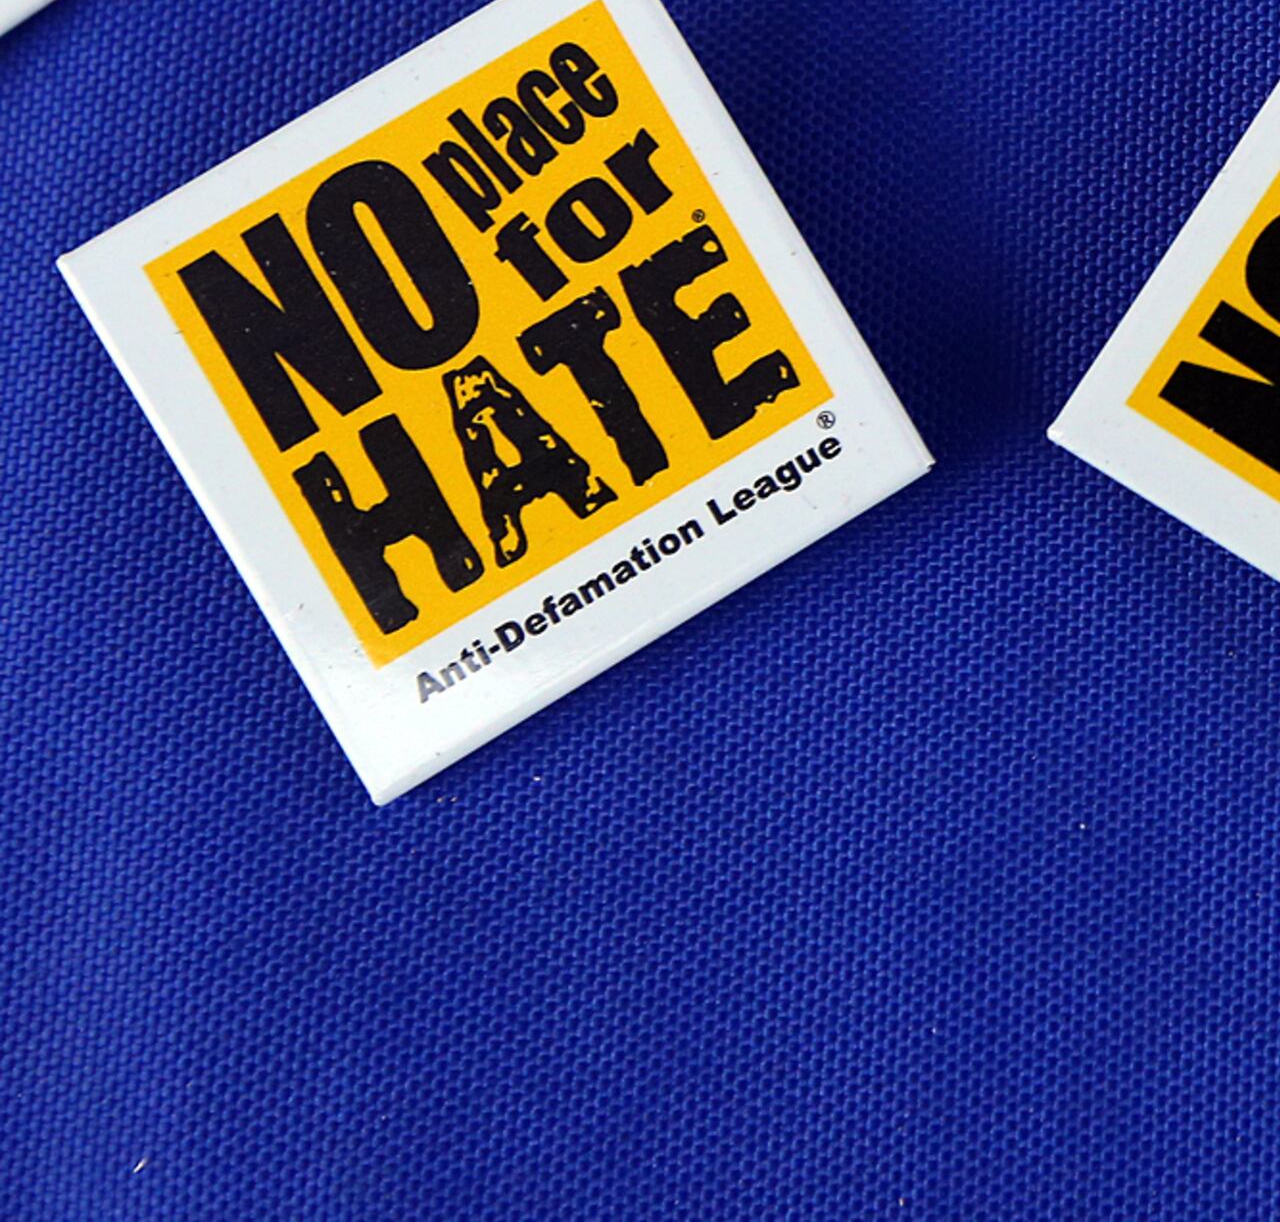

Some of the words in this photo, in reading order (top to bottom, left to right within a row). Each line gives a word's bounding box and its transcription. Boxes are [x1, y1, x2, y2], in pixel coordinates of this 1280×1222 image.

[177, 158, 480, 454] NO
[421, 41, 620, 232] place
[494, 128, 660, 302] for
[414, 517, 705, 704] Anti-Defamation
